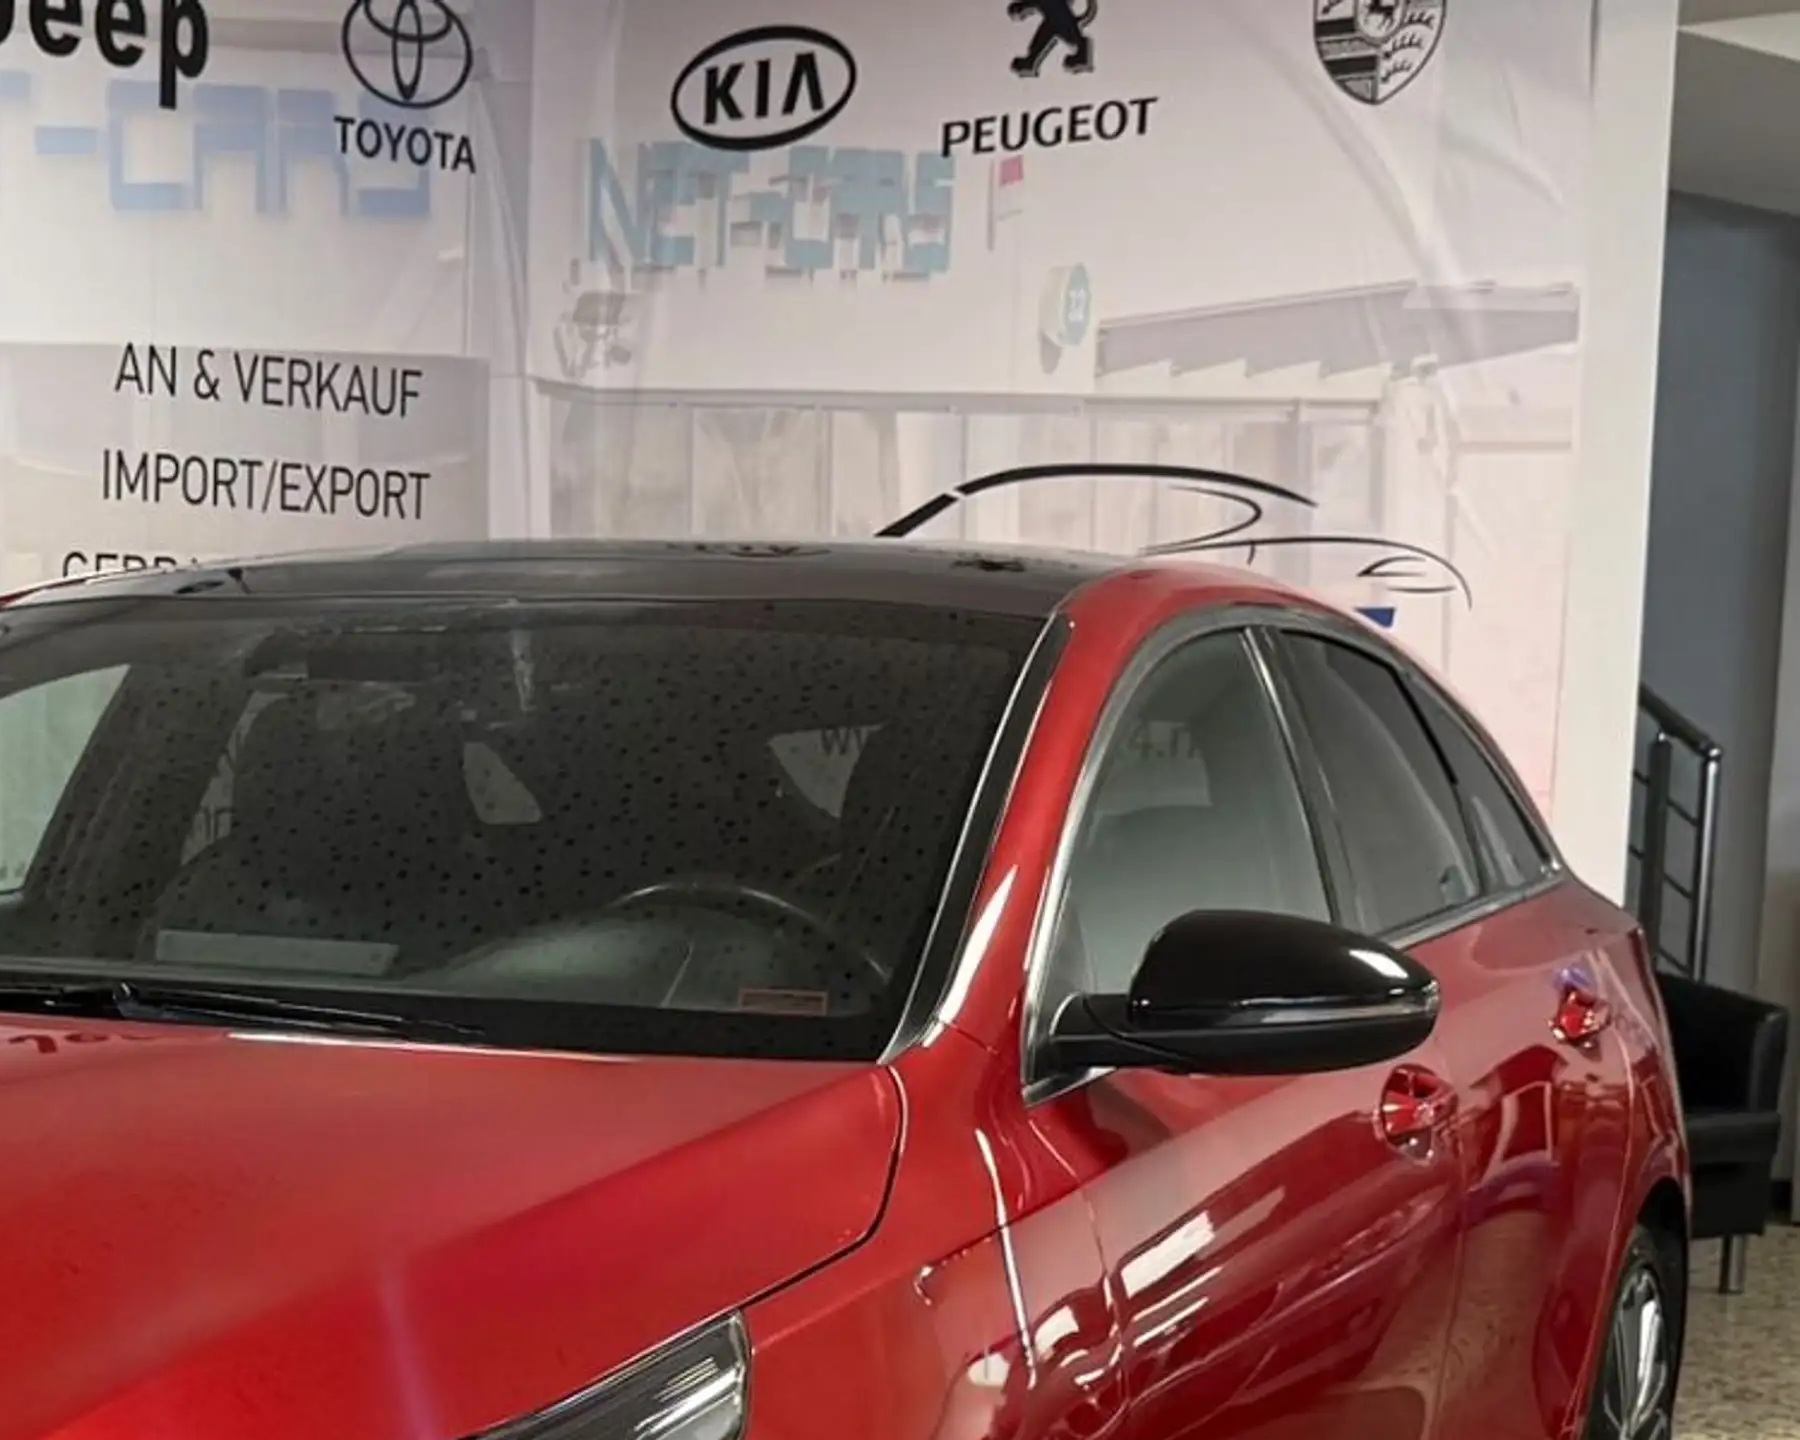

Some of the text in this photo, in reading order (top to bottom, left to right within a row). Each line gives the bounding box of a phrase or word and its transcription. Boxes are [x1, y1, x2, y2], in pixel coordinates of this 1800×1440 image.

[702, 51, 825, 125] KIA
[333, 115, 477, 174] TOYOTA
[941, 97, 1159, 158] PEUGEOT
[114, 341, 424, 418] AN & VERKAUF
[102, 448, 432, 520] IMPORT/EXPORT
